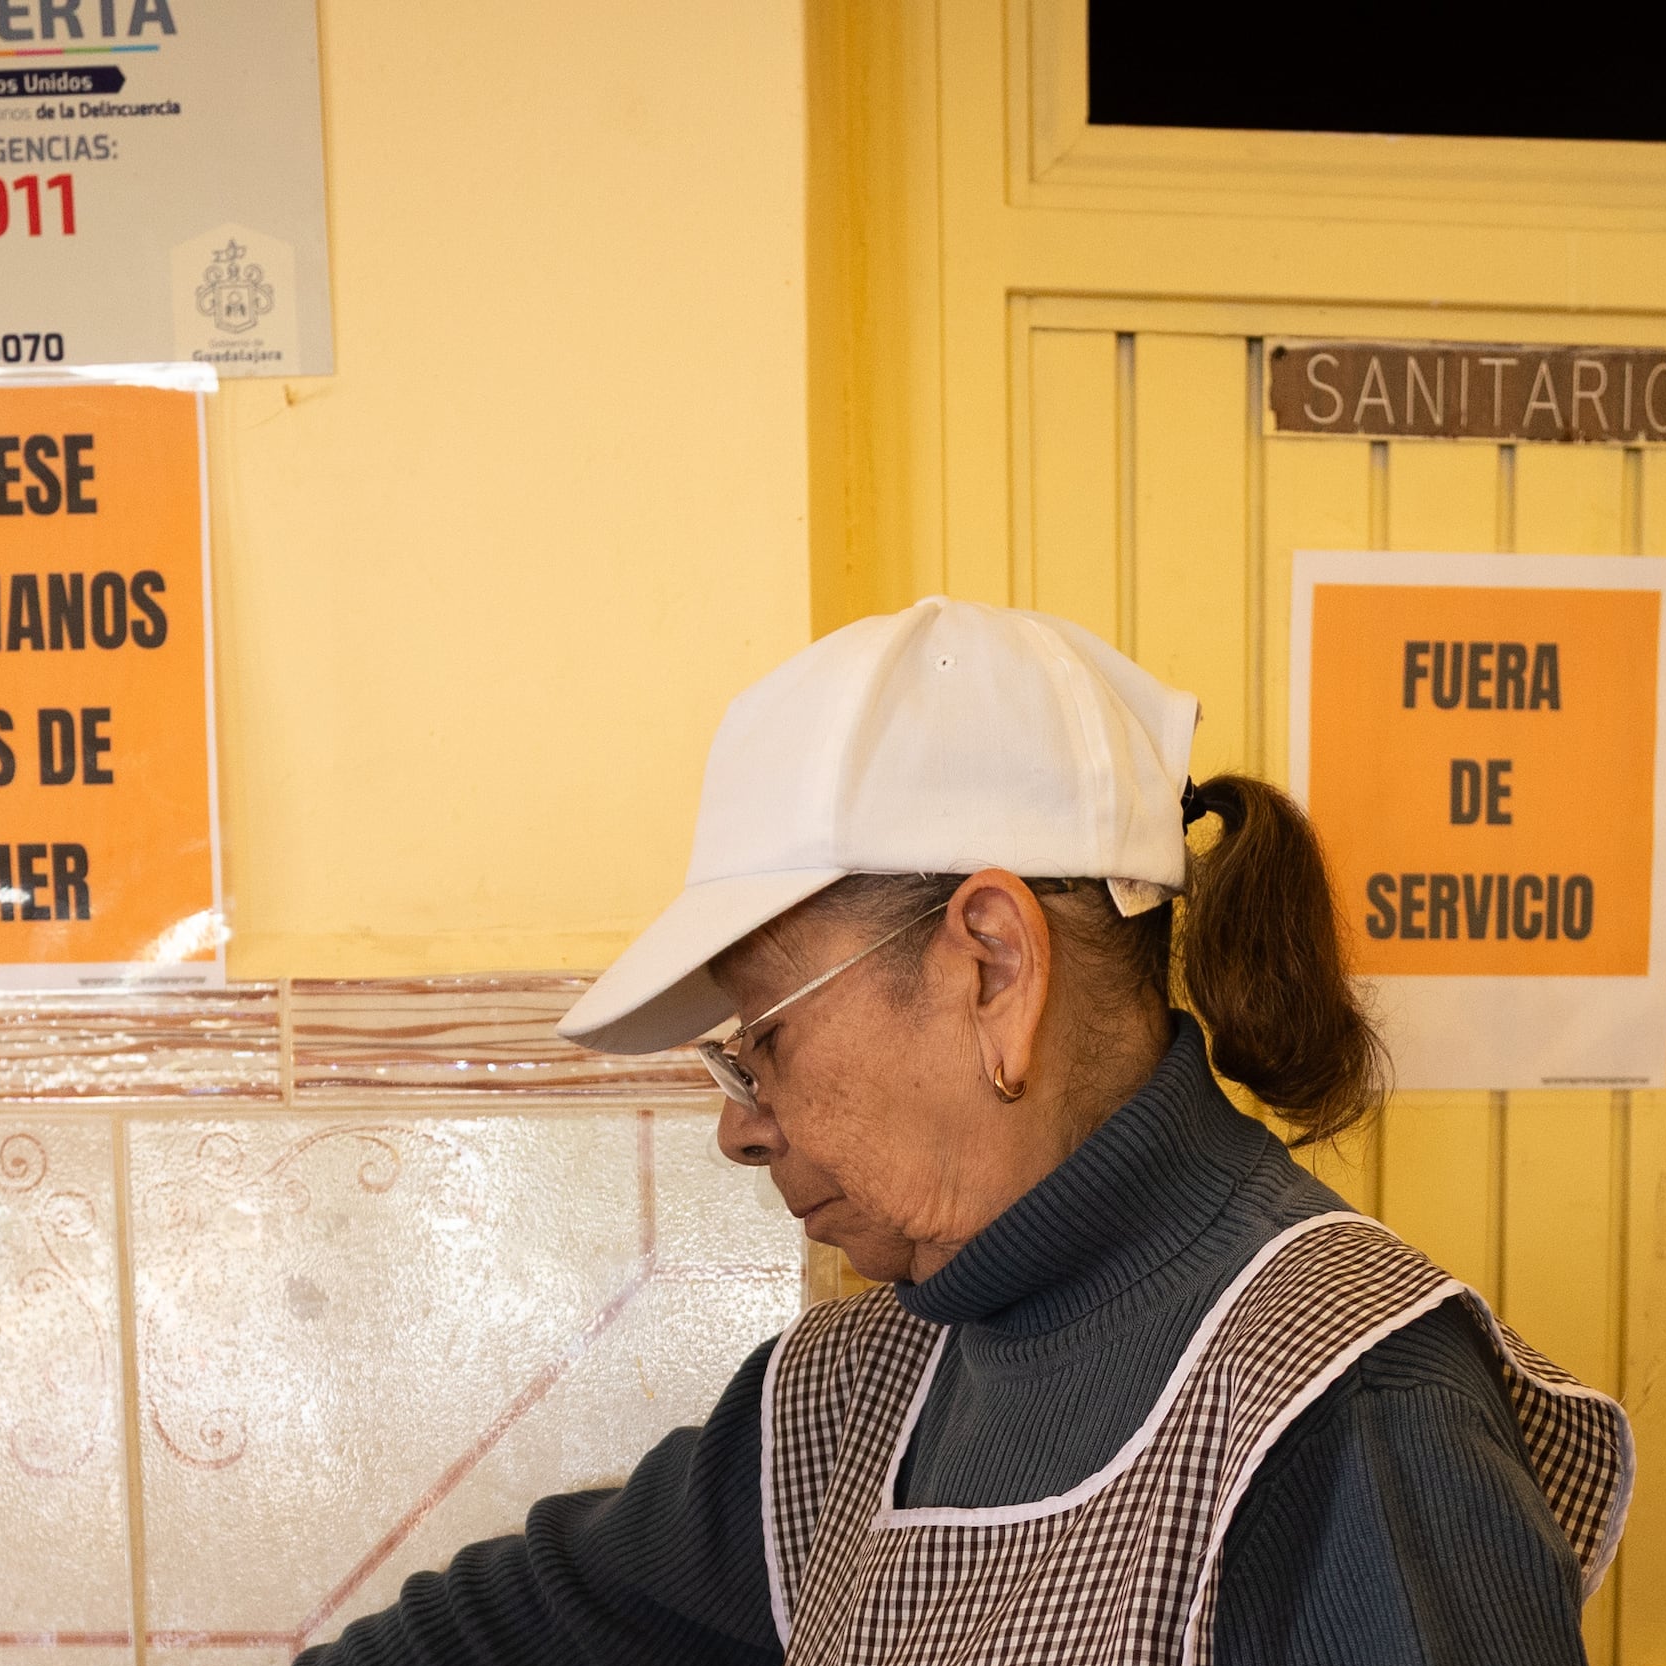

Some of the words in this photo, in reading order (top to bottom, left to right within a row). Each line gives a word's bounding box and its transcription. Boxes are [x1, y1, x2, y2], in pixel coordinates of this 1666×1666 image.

[23, 72, 93, 94] Unidos
[36, 102, 54, 119] de
[59, 101, 75, 118] la
[79, 100, 180, 119] Delincuencia
[1402, 640, 1561, 711] FUERA
[38, 707, 114, 785] DE
[1450, 759, 1513, 825] DE
[1365, 873, 1594, 941] SERVICIO
